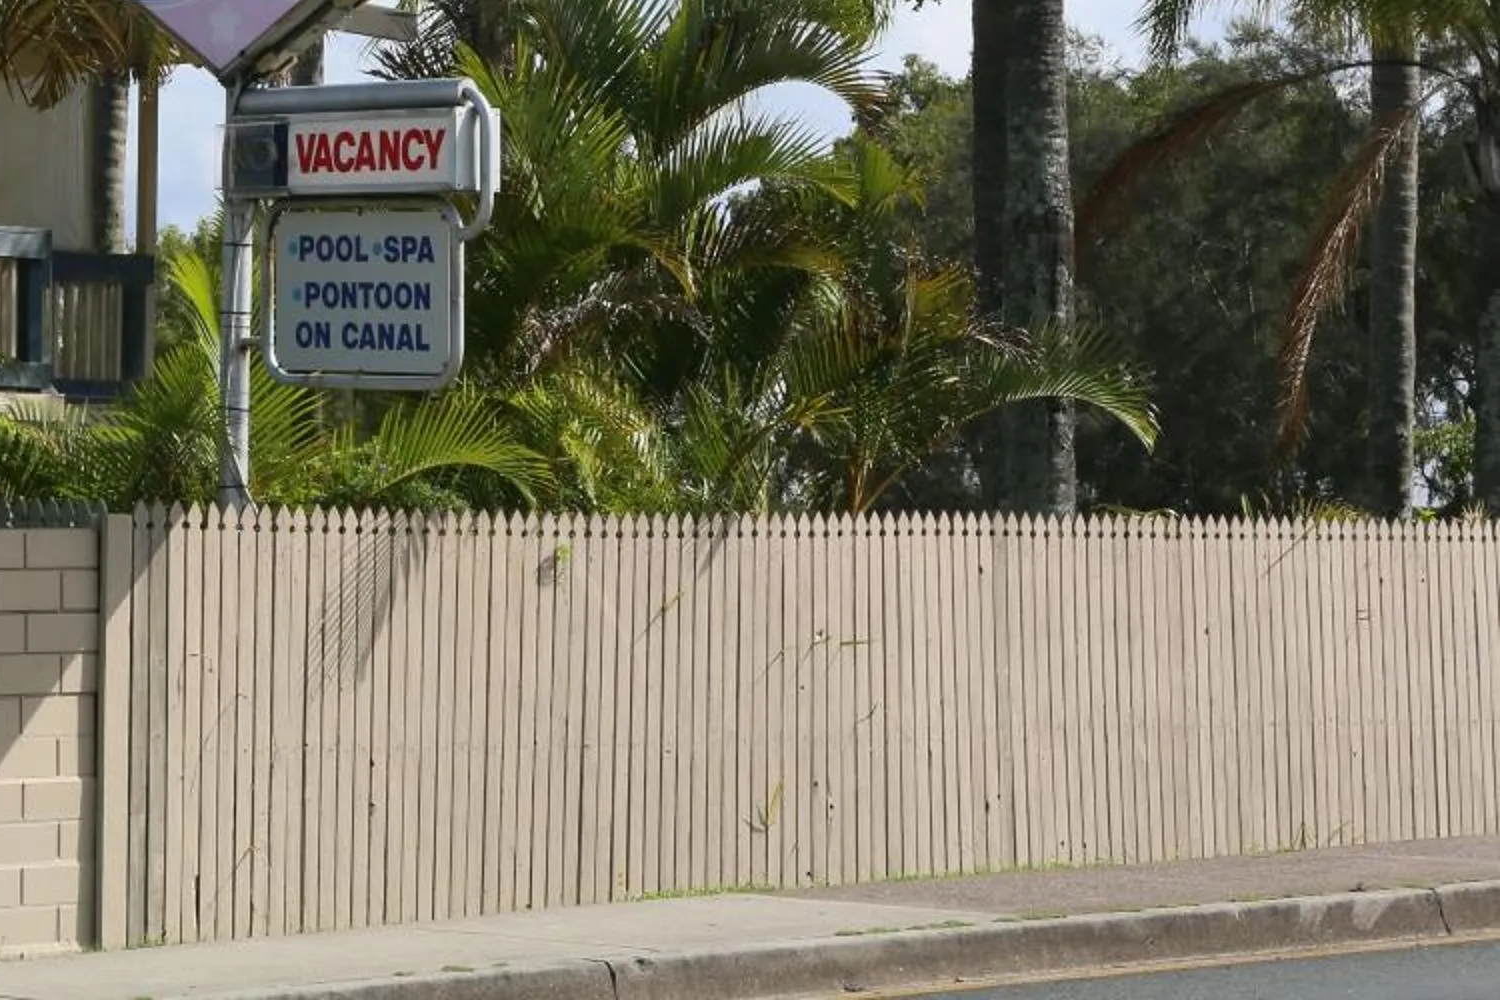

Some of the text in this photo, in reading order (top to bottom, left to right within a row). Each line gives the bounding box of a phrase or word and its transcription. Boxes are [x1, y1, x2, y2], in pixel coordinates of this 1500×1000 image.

[295, 129, 445, 174] VACANCY
[299, 235, 435, 263] POOL SPA
[305, 282, 431, 310] PONTOON
[295, 322, 430, 351] ON CANAL
